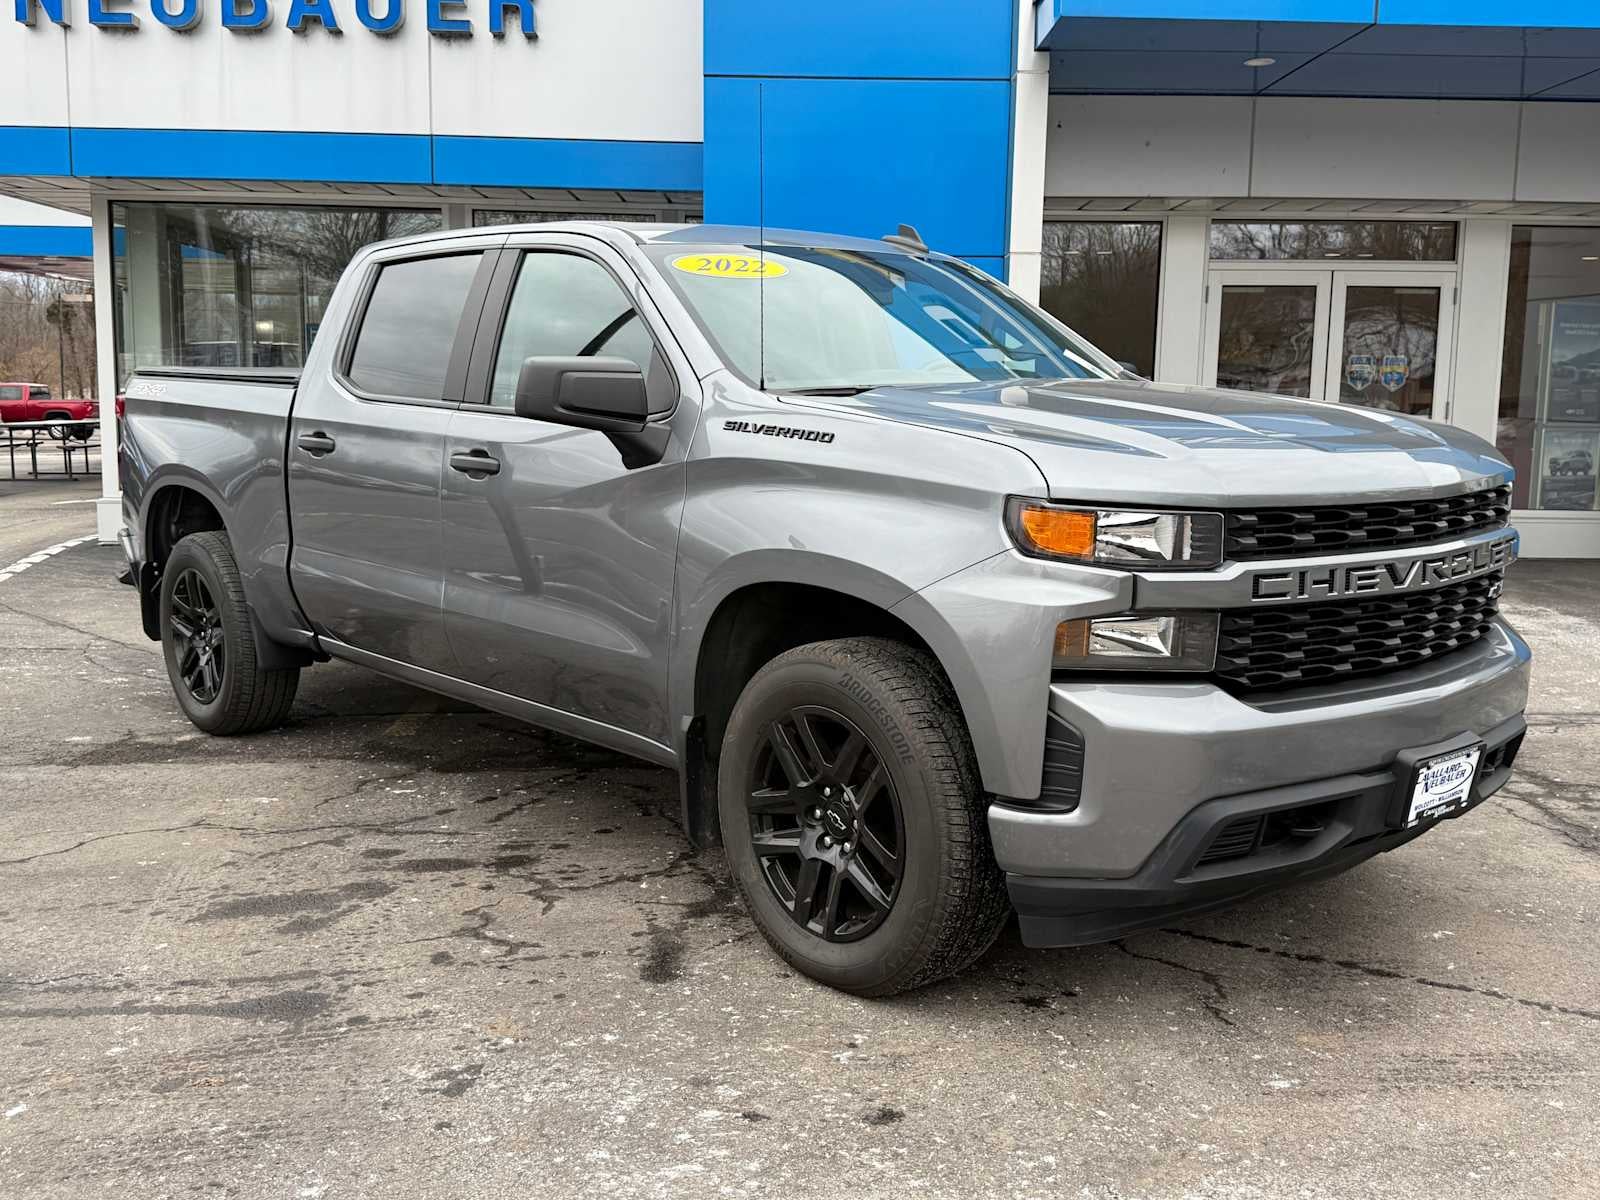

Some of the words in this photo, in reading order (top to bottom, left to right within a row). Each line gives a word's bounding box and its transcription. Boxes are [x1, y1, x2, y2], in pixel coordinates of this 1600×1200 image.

[697, 257, 767, 273] 2022
[723, 420, 835, 444] SILVERADO
[1251, 538, 1517, 602] CHEVROLET
[839, 672, 914, 765] BRIDGESTONE
